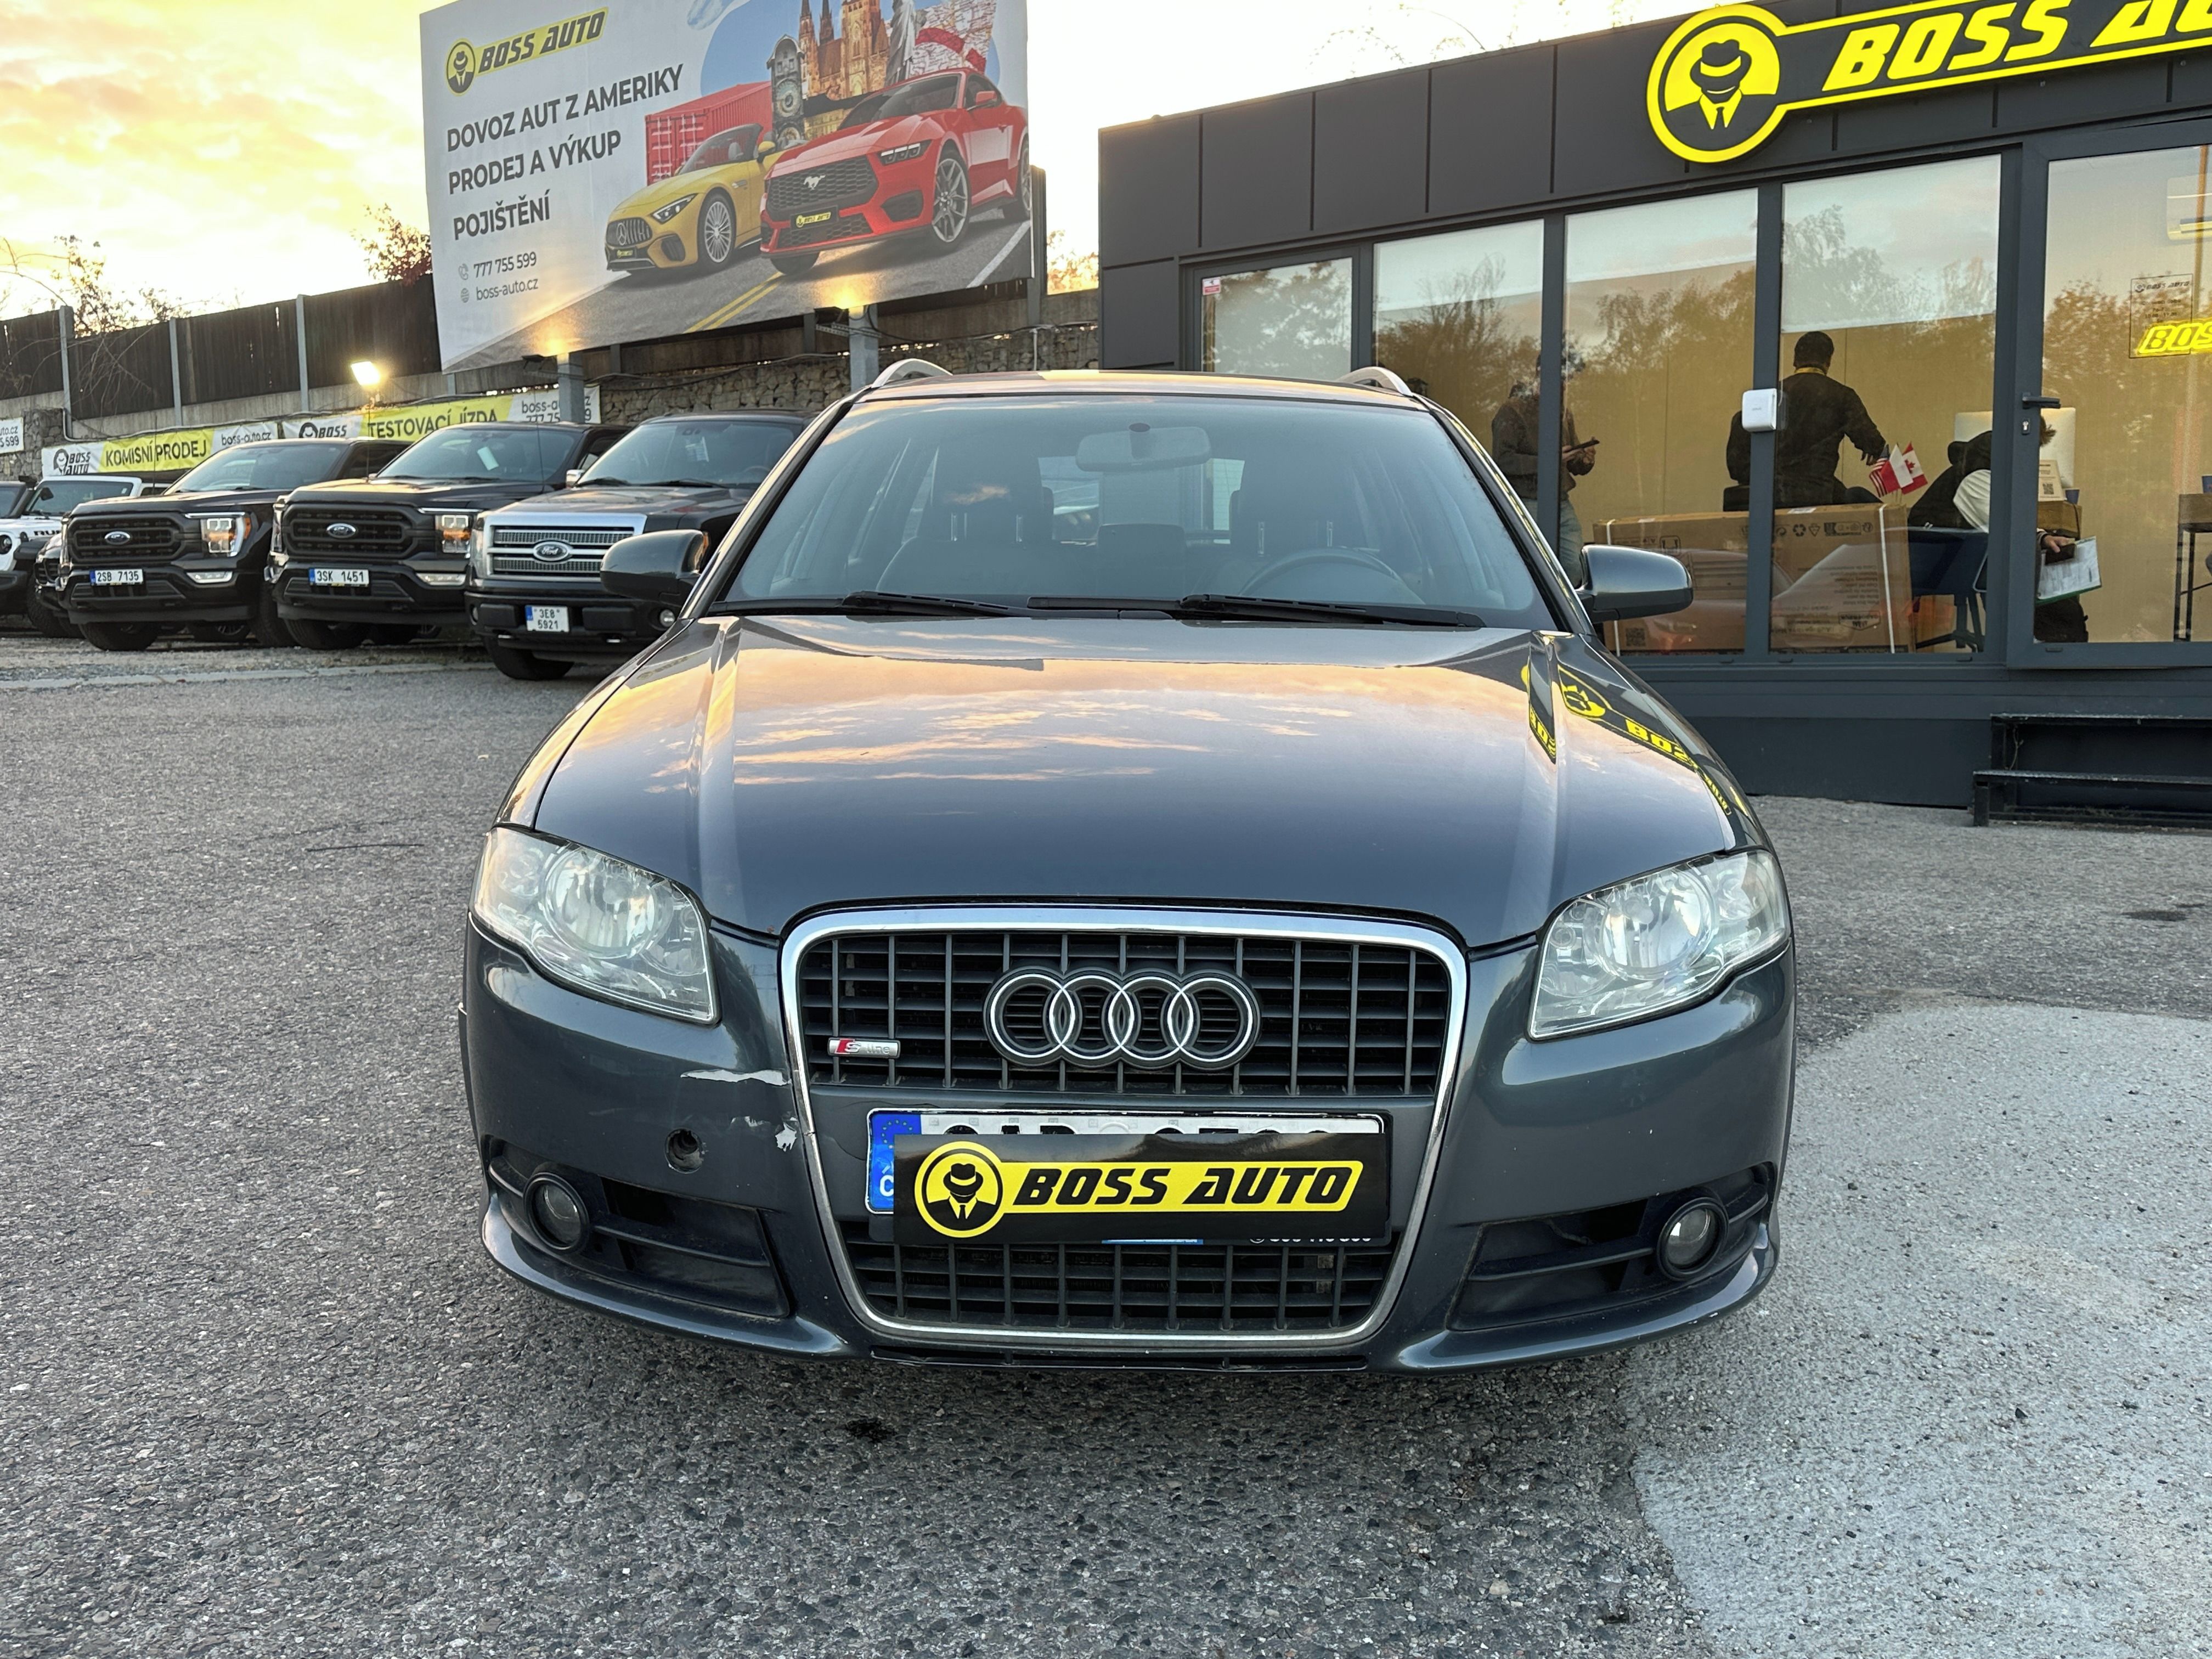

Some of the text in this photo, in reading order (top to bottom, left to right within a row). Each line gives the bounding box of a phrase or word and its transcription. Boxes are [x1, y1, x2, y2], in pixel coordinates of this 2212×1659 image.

[478, 11, 606, 74] BOSS AUTO
[1822, 0, 2072, 92] BOSS
[447, 64, 684, 151] DOVOZ AUT Z AMERIKY
[449, 130, 622, 194] PRODEJ A VÝKUP
[453, 189, 551, 240] POJIŠTĚNÍ
[473, 251, 537, 278] 777 755 599
[476, 279, 539, 301] boss-auto.cz
[318, 424, 347, 438] BOSS
[368, 408, 452, 438] TESTOVACÍ
[5, 435, 19, 447] 599
[105, 439, 207, 467] KOMISNÍ PRODEJ
[65, 463, 89, 475] AUTO
[69, 452, 91, 464] BOSS
[97, 571, 139, 582] 2SB 7135
[317, 571, 364, 583] 3SK 1451
[538, 619, 558, 629] 5921
[1012, 1166, 1353, 1206] BOSS AUTO
